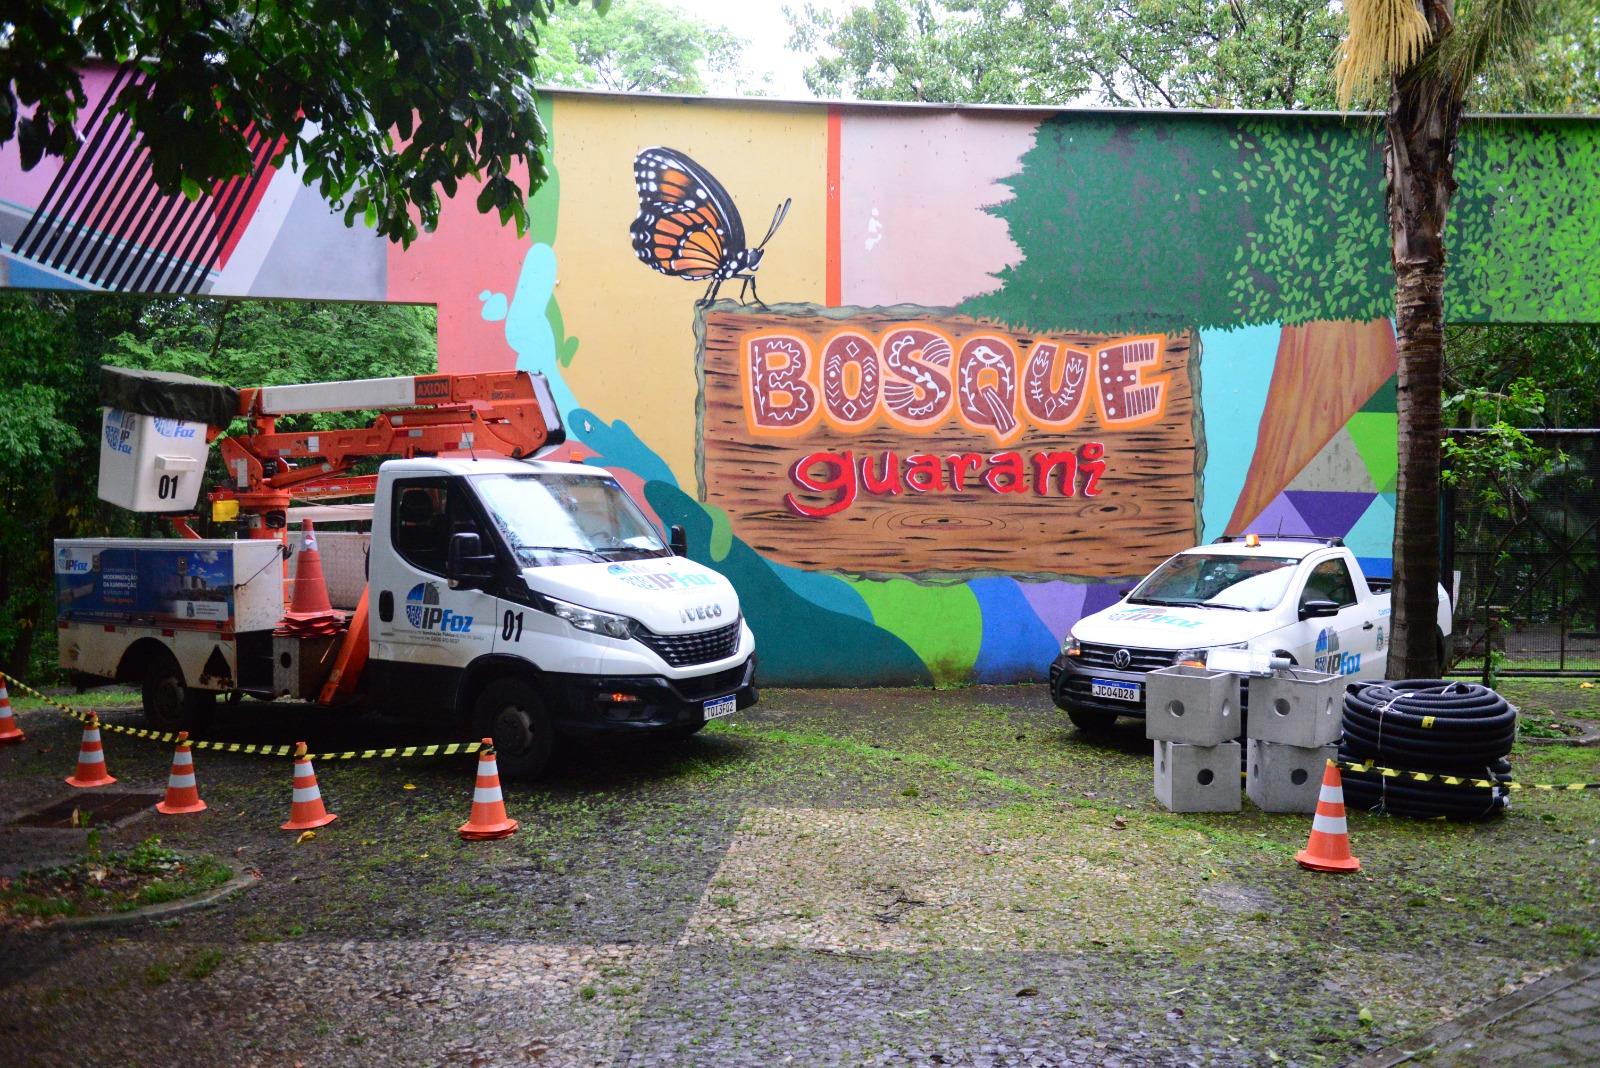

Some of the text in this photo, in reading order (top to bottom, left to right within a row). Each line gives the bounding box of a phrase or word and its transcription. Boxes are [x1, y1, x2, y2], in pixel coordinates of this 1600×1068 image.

[416, 382, 448, 396] AXION
[743, 326, 1169, 440] BOSQUE
[158, 474, 179, 500] 01
[784, 442, 1106, 518] guarani
[501, 609, 524, 642] 01
[679, 603, 722, 624] IVECO
